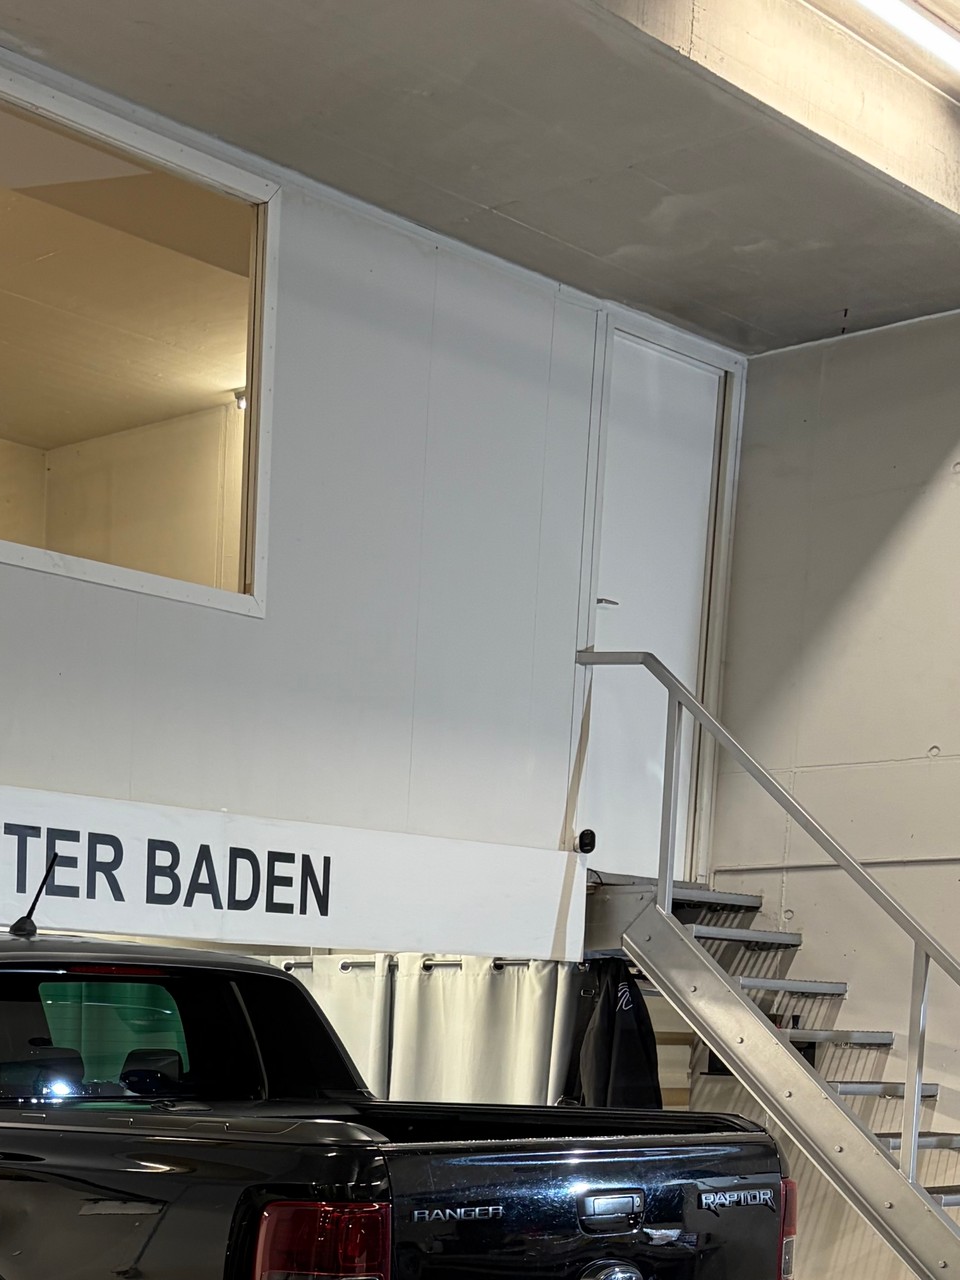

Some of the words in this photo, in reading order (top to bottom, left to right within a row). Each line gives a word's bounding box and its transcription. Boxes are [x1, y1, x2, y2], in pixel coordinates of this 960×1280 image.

[145, 838, 332, 917] BADEN
[700, 1189, 776, 1212] RAPTOR
[413, 1205, 503, 1222] RANGER
